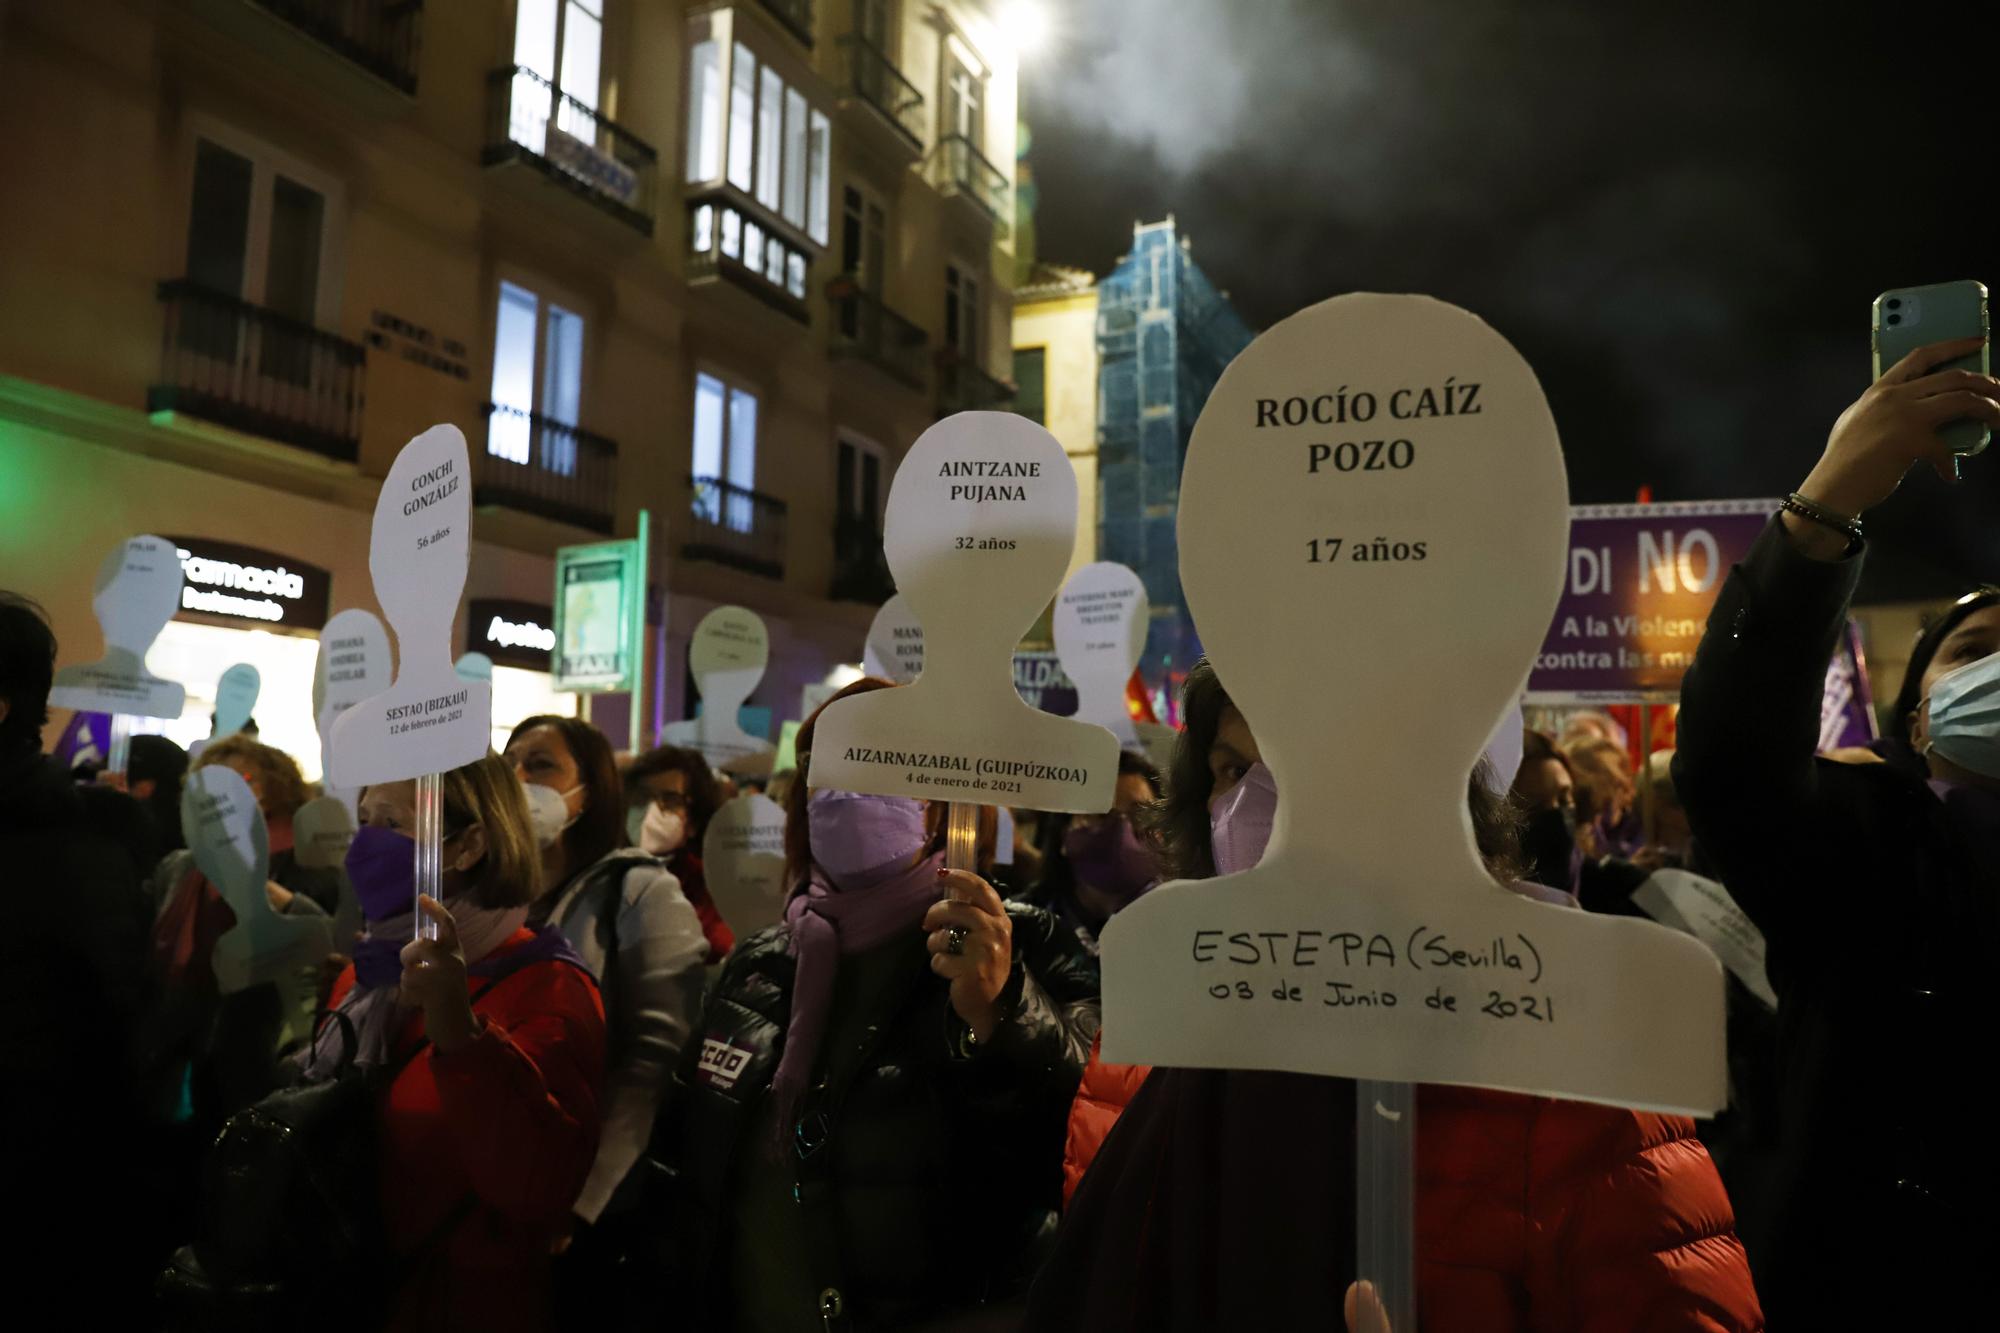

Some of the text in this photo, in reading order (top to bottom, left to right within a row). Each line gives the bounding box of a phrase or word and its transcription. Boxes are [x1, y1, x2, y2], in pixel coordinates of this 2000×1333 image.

[1255, 376, 1482, 428] ROCÍO CAÍZ
[939, 461, 1041, 478] AINTZANE
[1307, 438, 1415, 473] POZO
[412, 458, 454, 492] CONCHI
[402, 475, 459, 517] GONZÁLEZ
[950, 485, 1027, 503] PUJANA
[417, 525, 451, 550] 56 años
[955, 536, 1017, 551] 32 años
[1306, 536, 1427, 563] 17 años
[1570, 528, 1721, 596] DI NO
[1561, 616, 1580, 638] A
[1586, 614, 1608, 638] la
[1618, 646, 1654, 669] las
[386, 688, 469, 721] SESTAO (BIZKAIA)
[390, 709, 463, 735] 12 de febrero de 2021
[843, 746, 1088, 786] AIZARNAZABAL (GUIPÚZKOA)
[906, 771, 1021, 794] 4 de enero de 2021
[1192, 926, 1543, 983] ESTEPA (Sevilla)
[1209, 979, 1553, 1022] 03 de Junio de 2021
